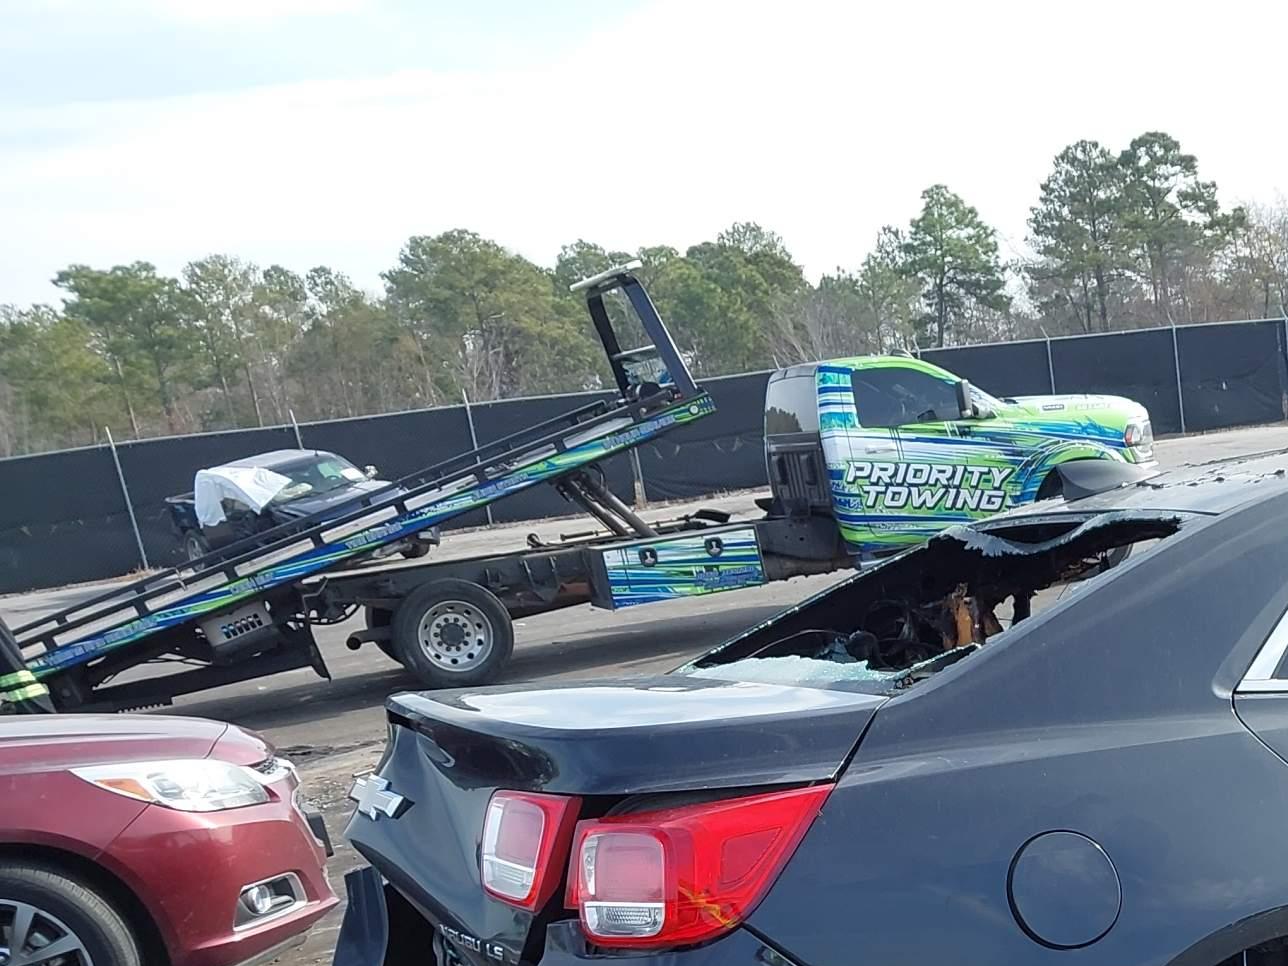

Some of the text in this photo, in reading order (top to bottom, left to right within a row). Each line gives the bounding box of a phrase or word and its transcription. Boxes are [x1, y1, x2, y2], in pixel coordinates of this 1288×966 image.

[846, 462, 1015, 490] PRIORITY
[862, 486, 1006, 512] TOWING
[485, 942, 505, 961] LS
